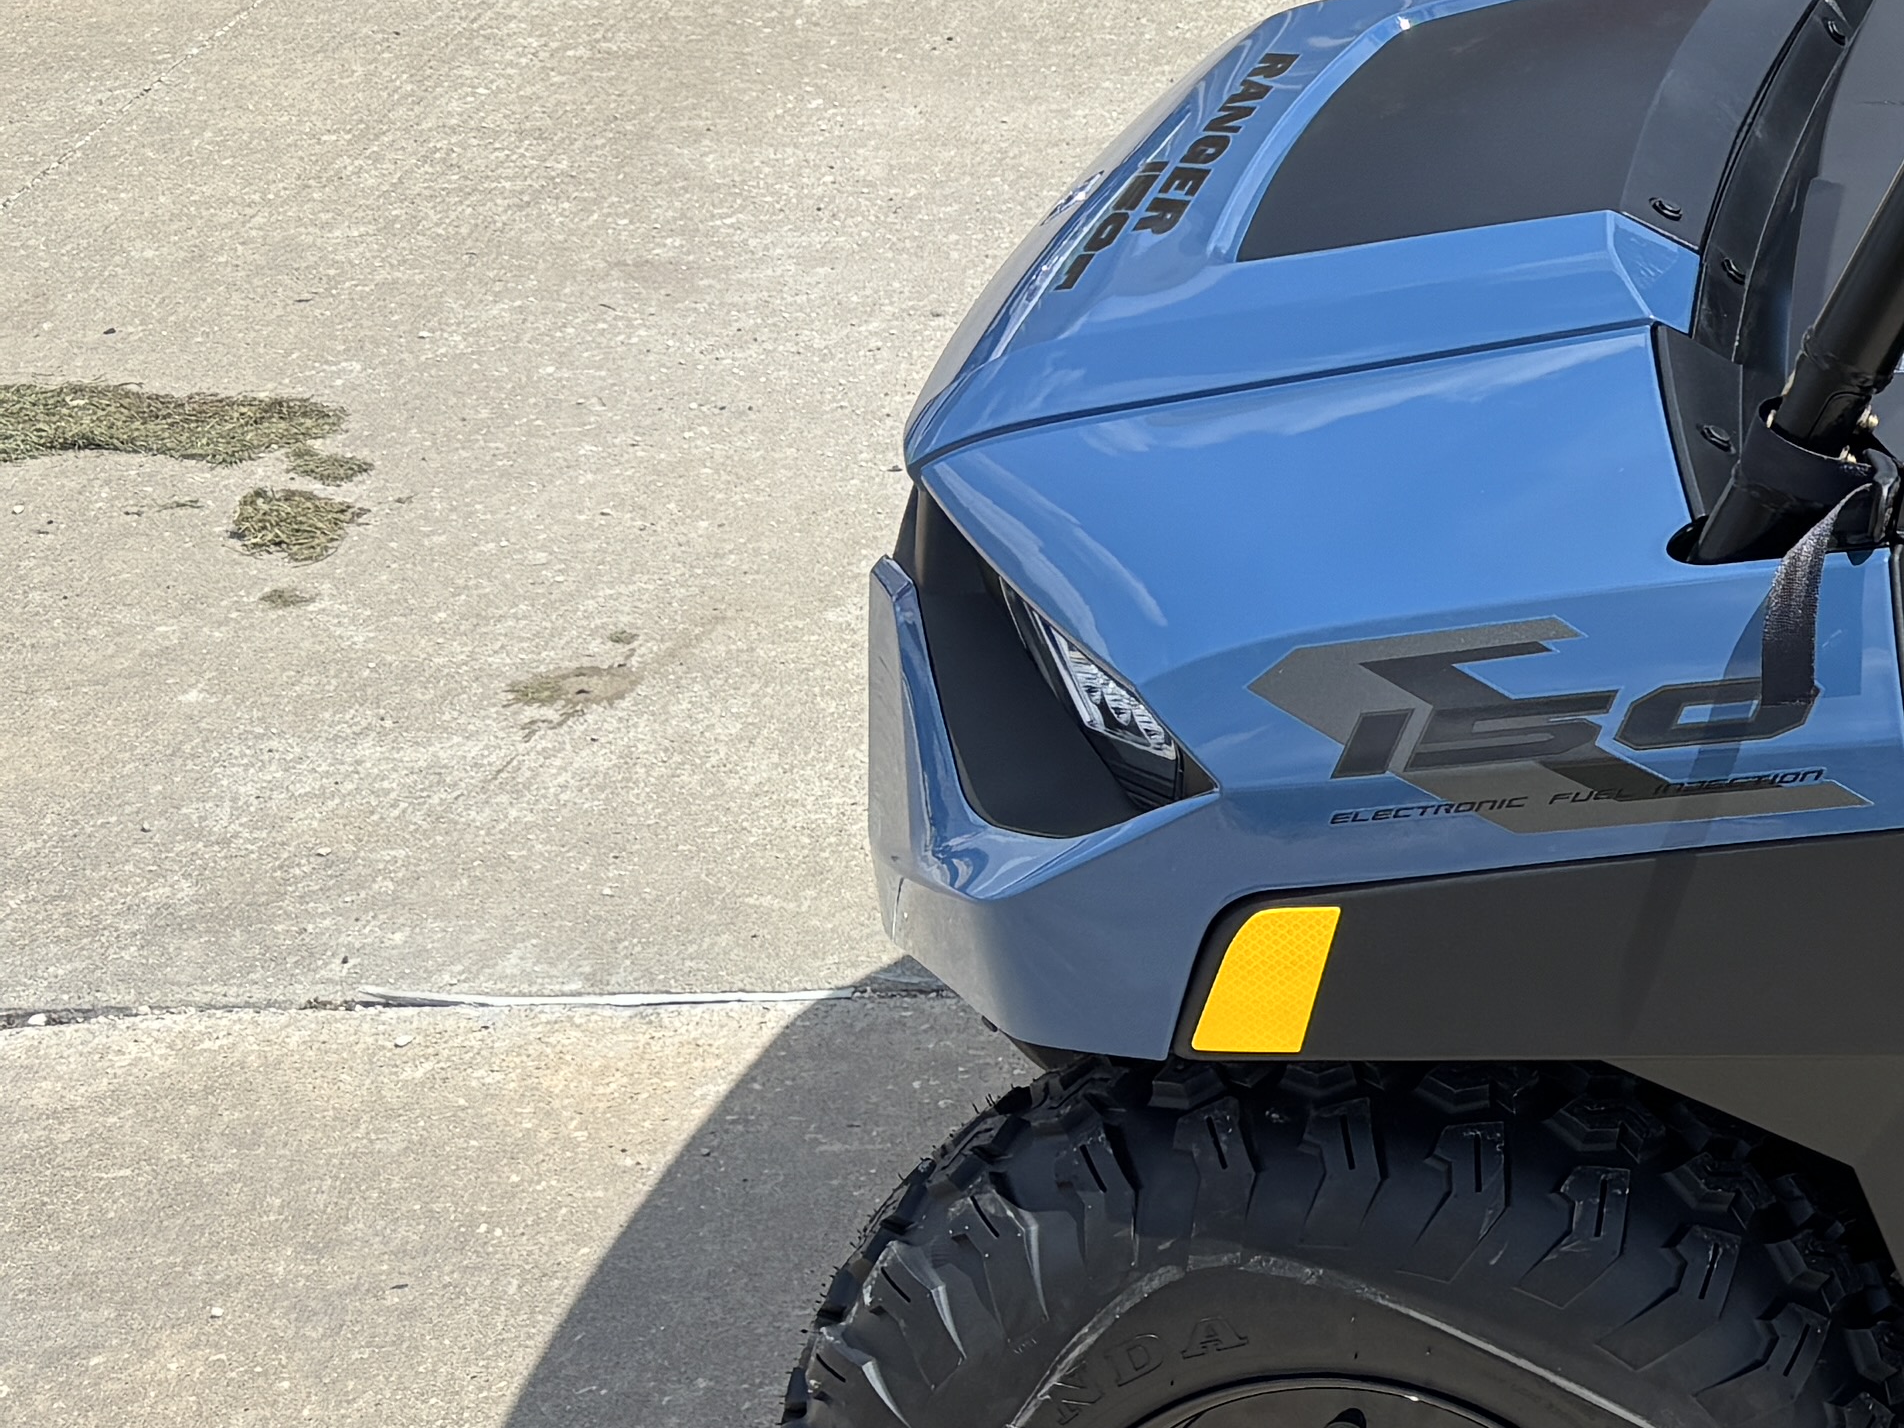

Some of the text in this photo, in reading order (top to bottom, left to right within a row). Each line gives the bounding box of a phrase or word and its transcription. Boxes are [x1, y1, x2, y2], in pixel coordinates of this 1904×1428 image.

[1131, 52, 1300, 236] RANGER
[1328, 768, 1827, 826] ELECTRONIC FUEL INJECTION
